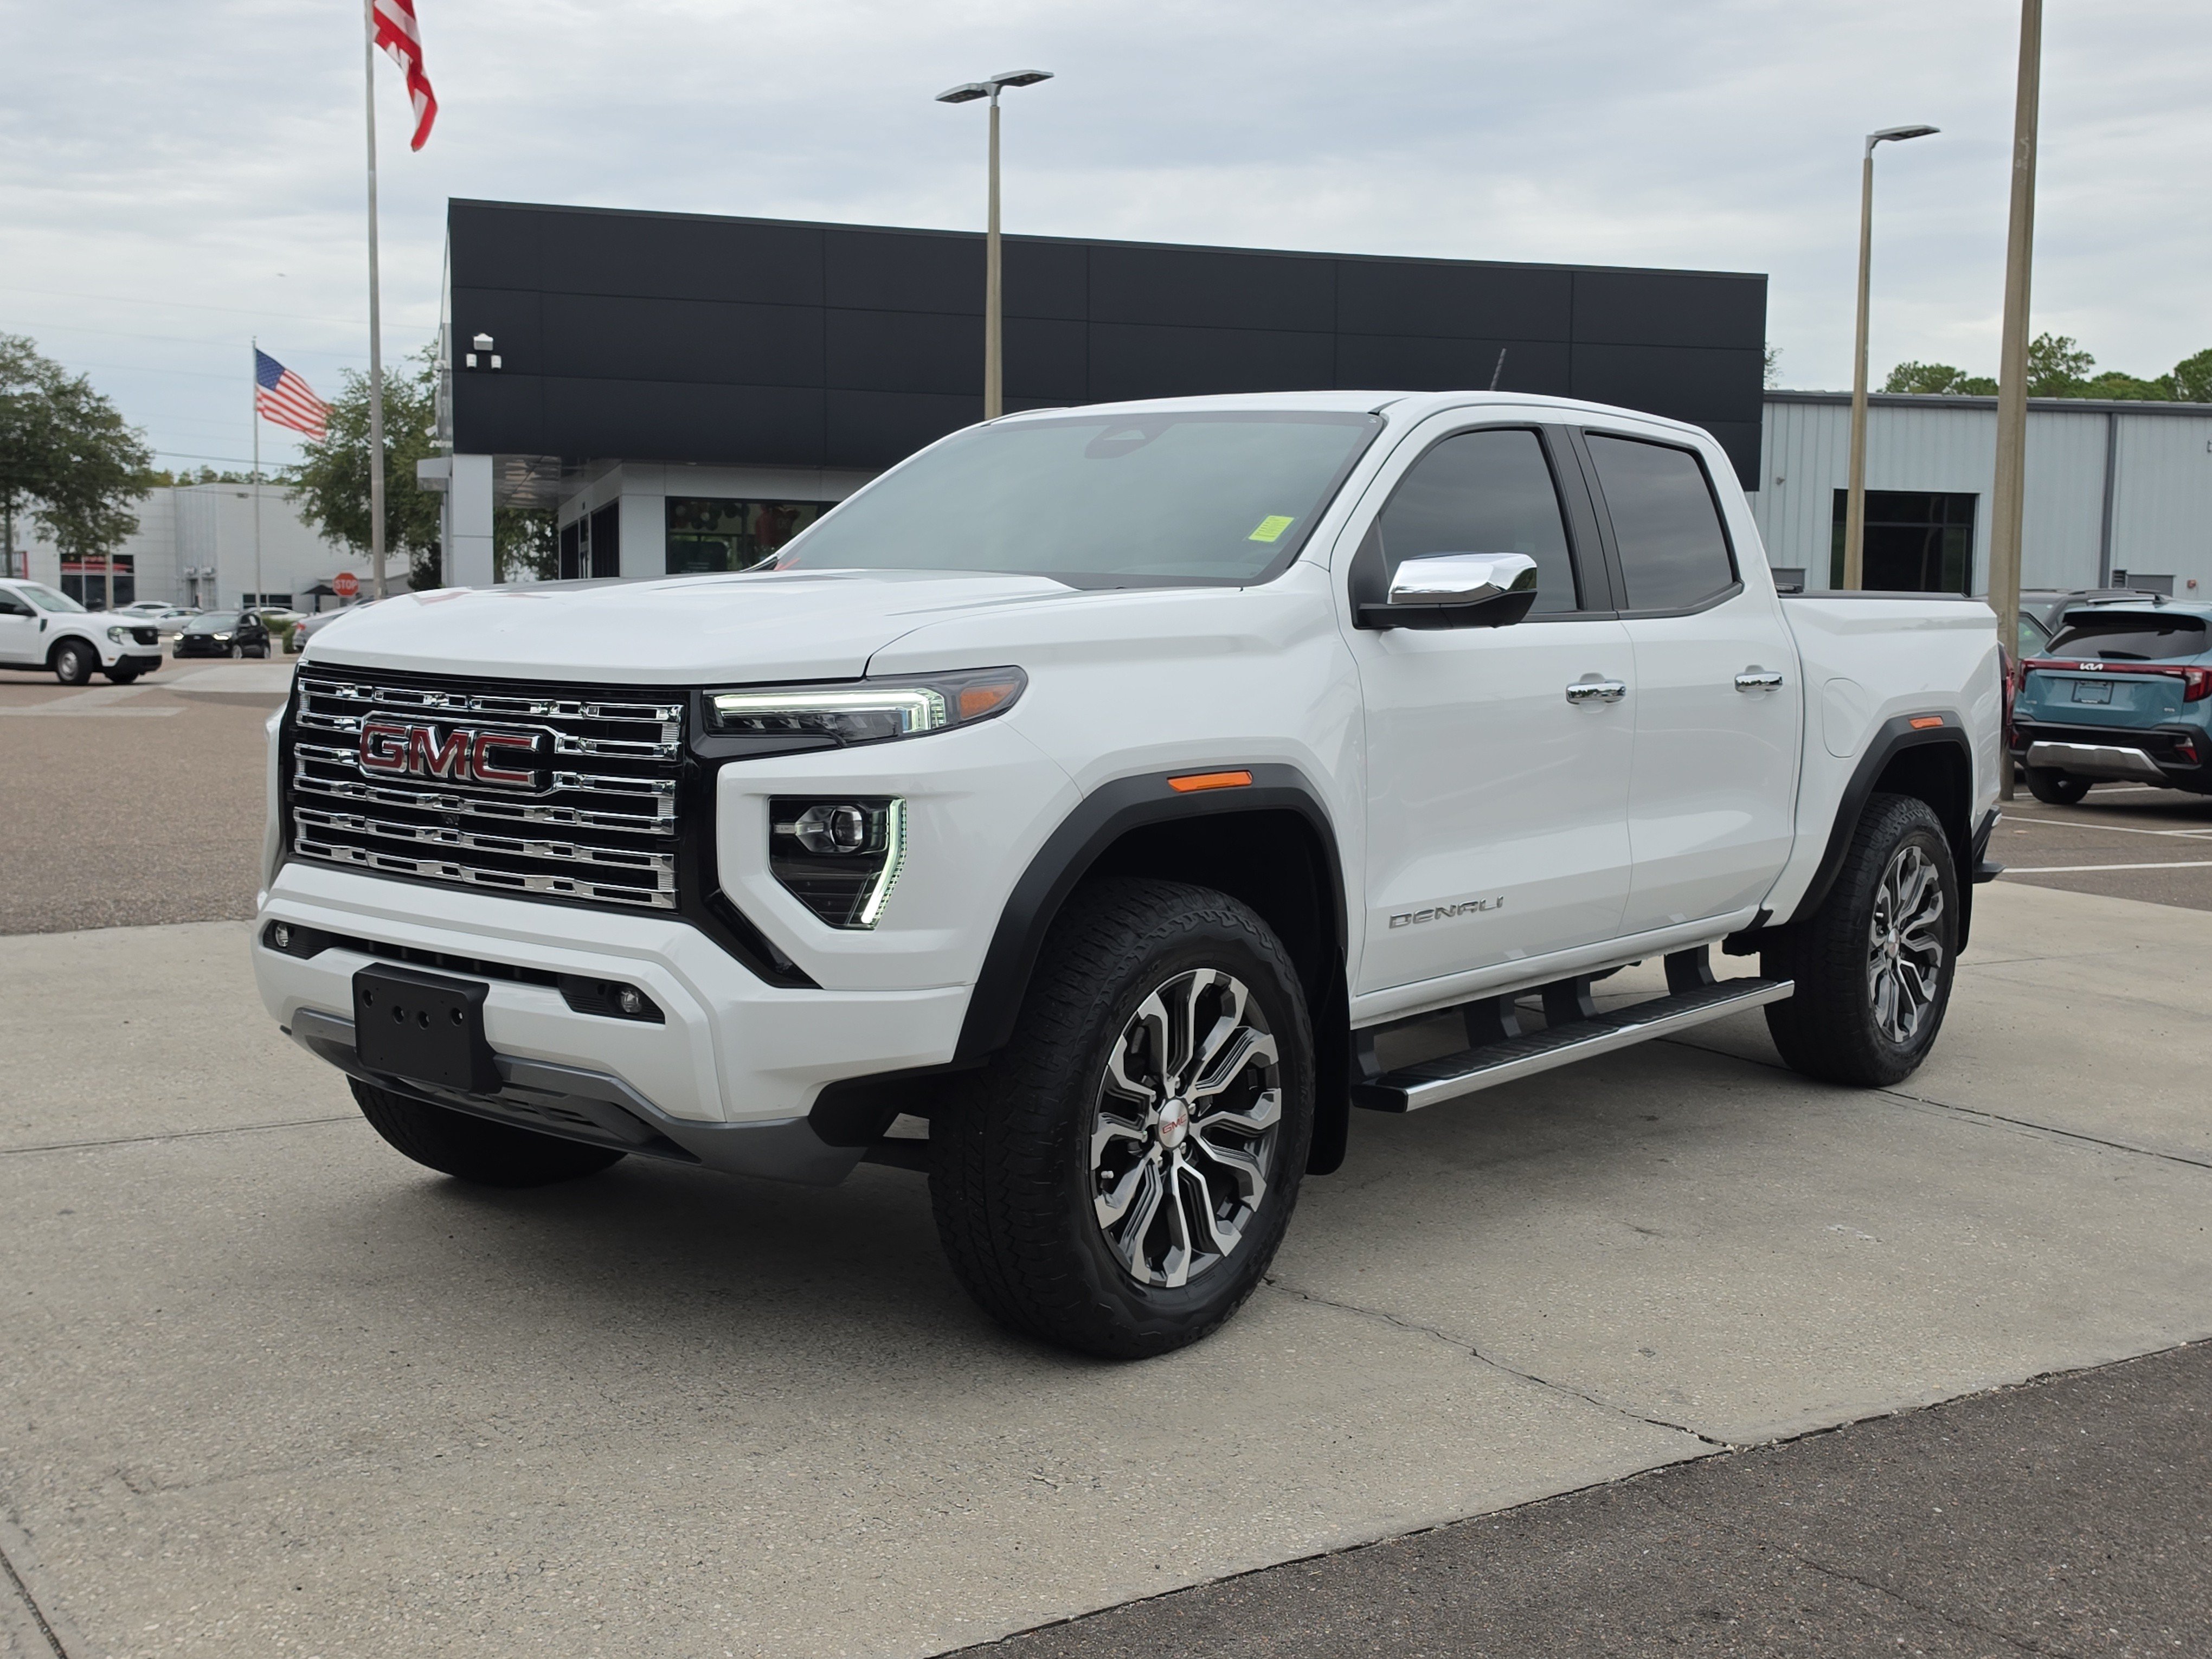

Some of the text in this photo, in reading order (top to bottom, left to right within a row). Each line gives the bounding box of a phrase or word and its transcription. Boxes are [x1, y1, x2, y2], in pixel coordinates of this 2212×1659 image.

[335, 579, 357, 590] STOP
[360, 722, 541, 787] GMC
[1389, 895, 1503, 929] DENALI
[1162, 1113, 1187, 1134] GMC
